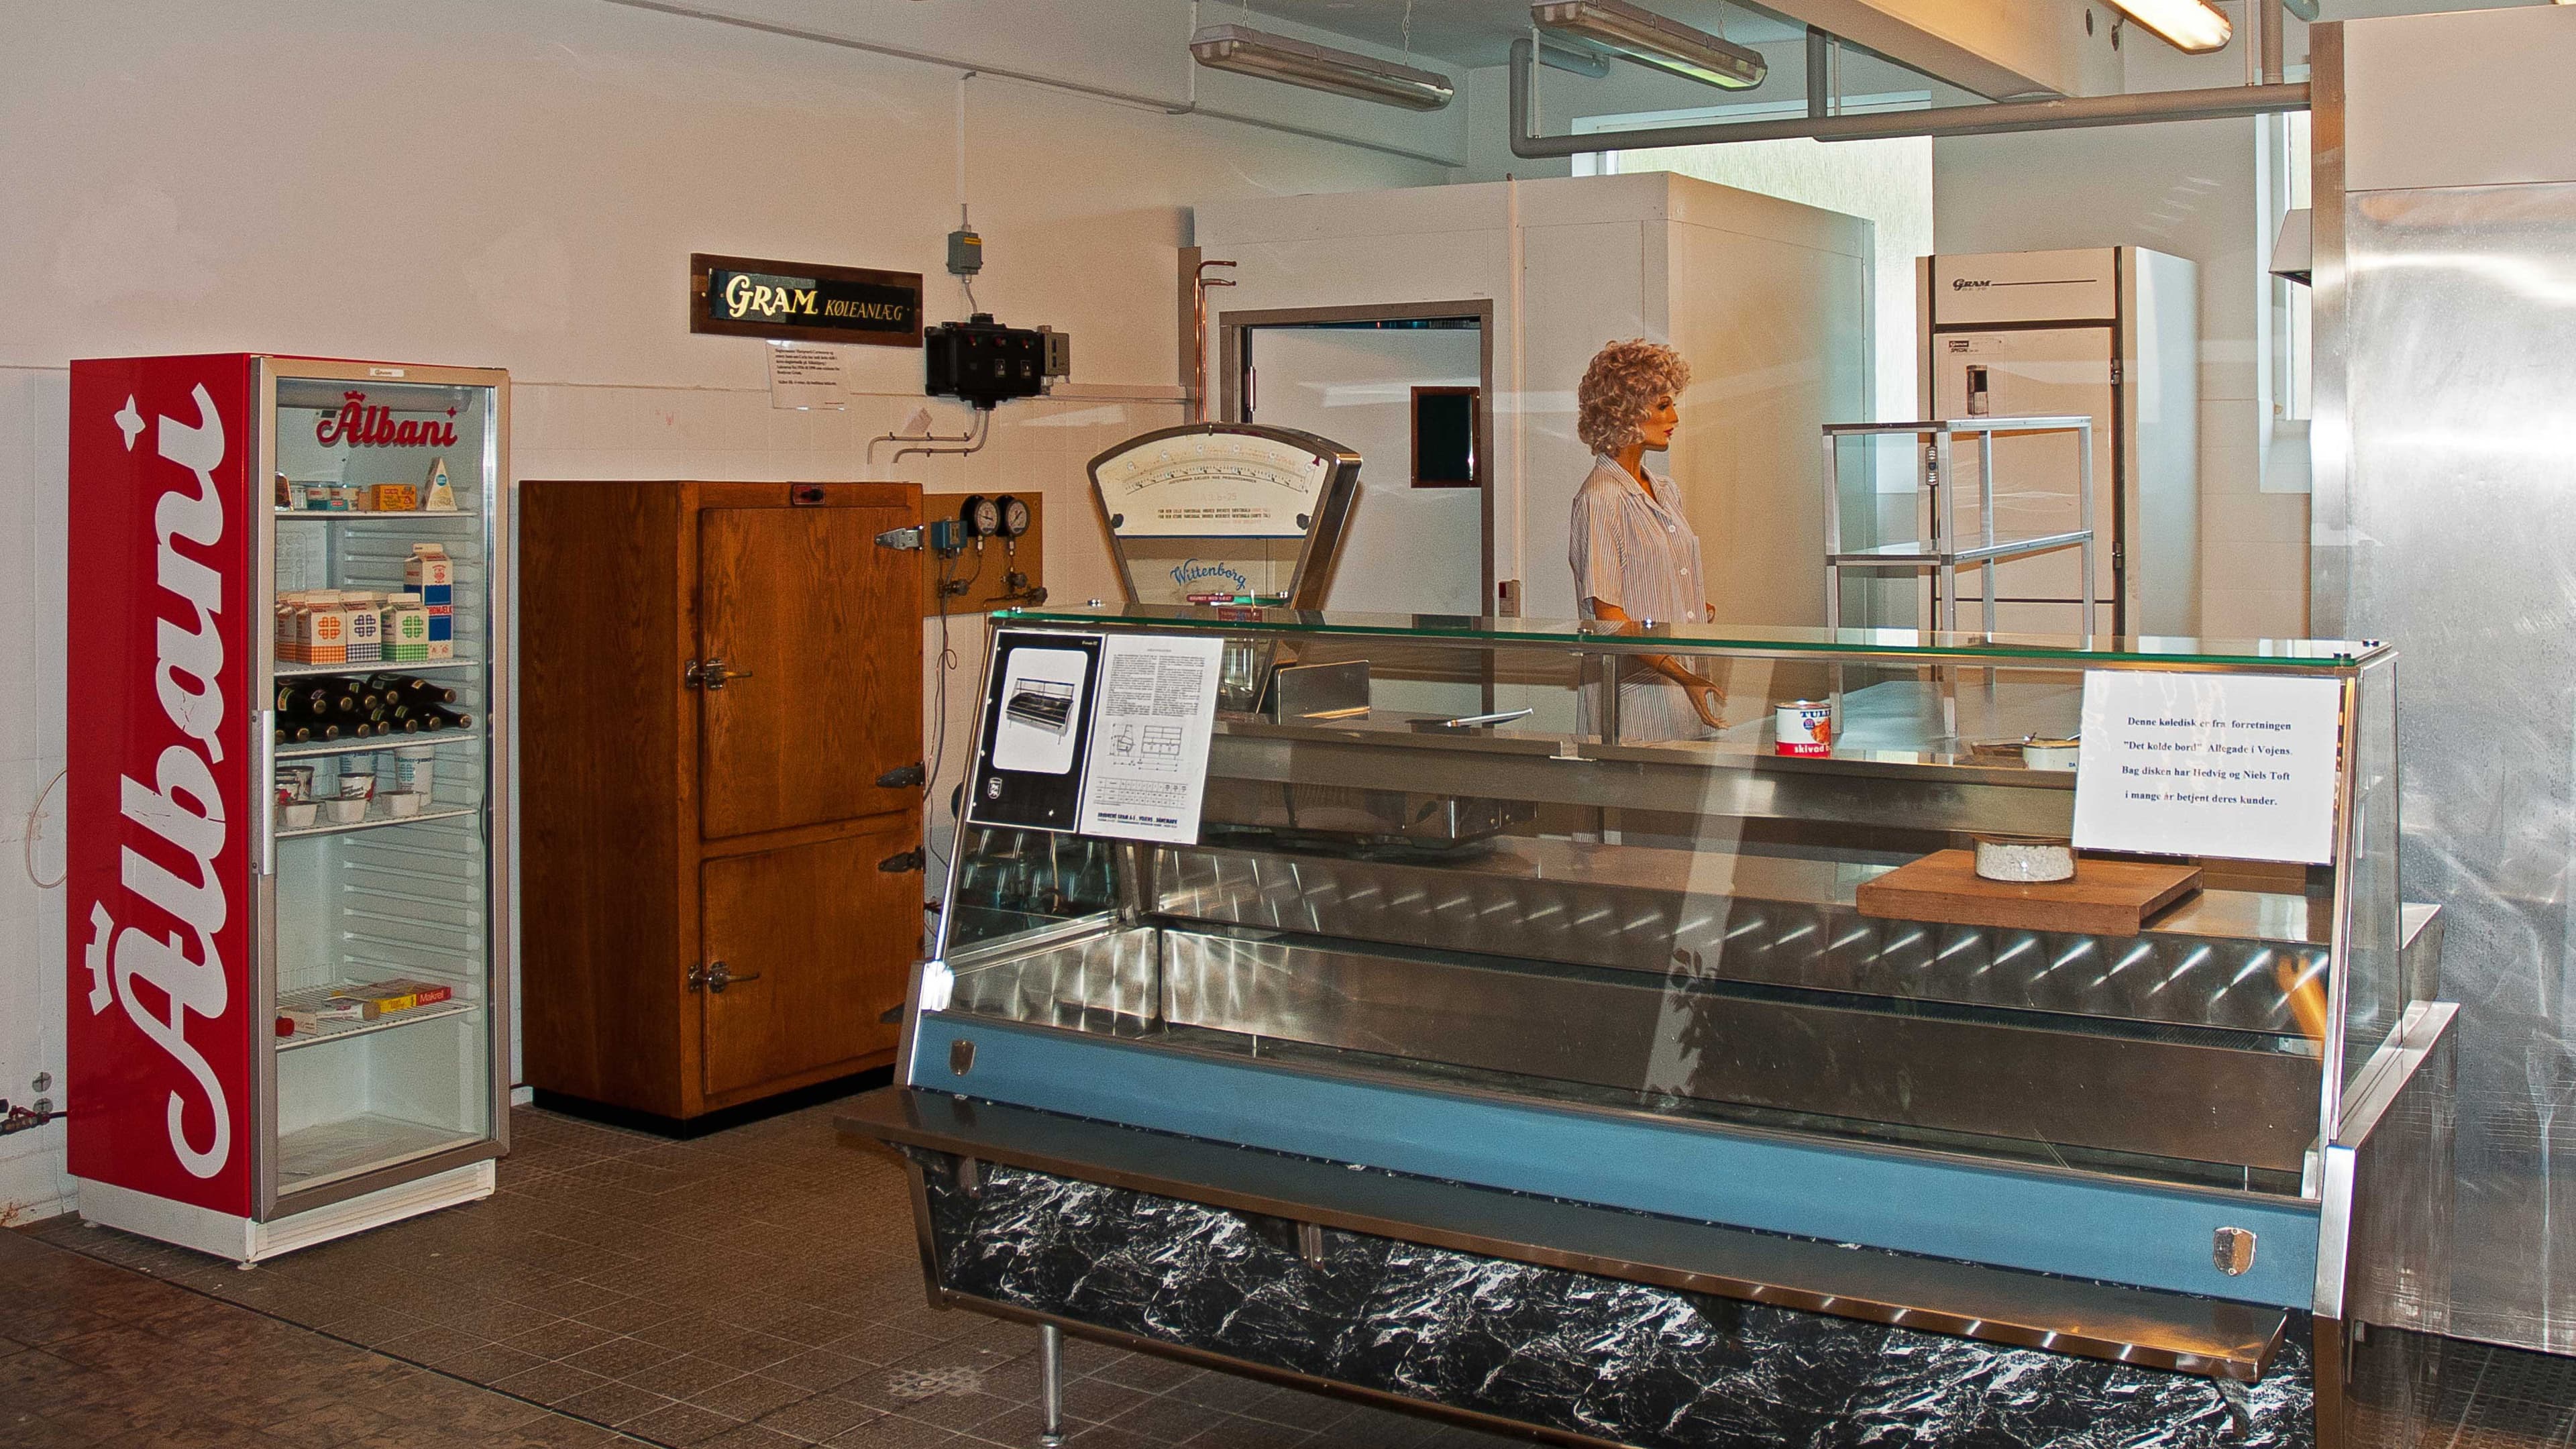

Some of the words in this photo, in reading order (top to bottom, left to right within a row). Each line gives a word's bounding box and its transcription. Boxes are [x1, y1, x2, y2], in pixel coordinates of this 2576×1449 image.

[1953, 278, 1991, 291] GRAM
[725, 274, 818, 317] GRAM
[824, 299, 904, 322] KØLEANLÆG
[316, 400, 458, 447] Albani
[1170, 558, 1246, 590] Wittenborg
[2128, 717, 2156, 727] Denne
[2159, 718, 2196, 727] køledisk
[2212, 719, 2225, 728] fra
[2231, 720, 2292, 731] forretningen
[2147, 742, 2172, 751] kolde
[2208, 745, 2248, 755] Allegade
[113, 382, 231, 1179] Albani
[2123, 766, 2139, 776] Bag
[2142, 767, 2171, 775] disken
[2174, 767, 2190, 776] har
[2193, 769, 2226, 779] Hedvig
[2243, 771, 2267, 780] Niels
[2269, 771, 2290, 781] Toft
[2131, 792, 2161, 800] mange
[2177, 792, 2209, 803] betjent
[2212, 794, 2237, 803] deres
[2240, 794, 2277, 805] kunder.
